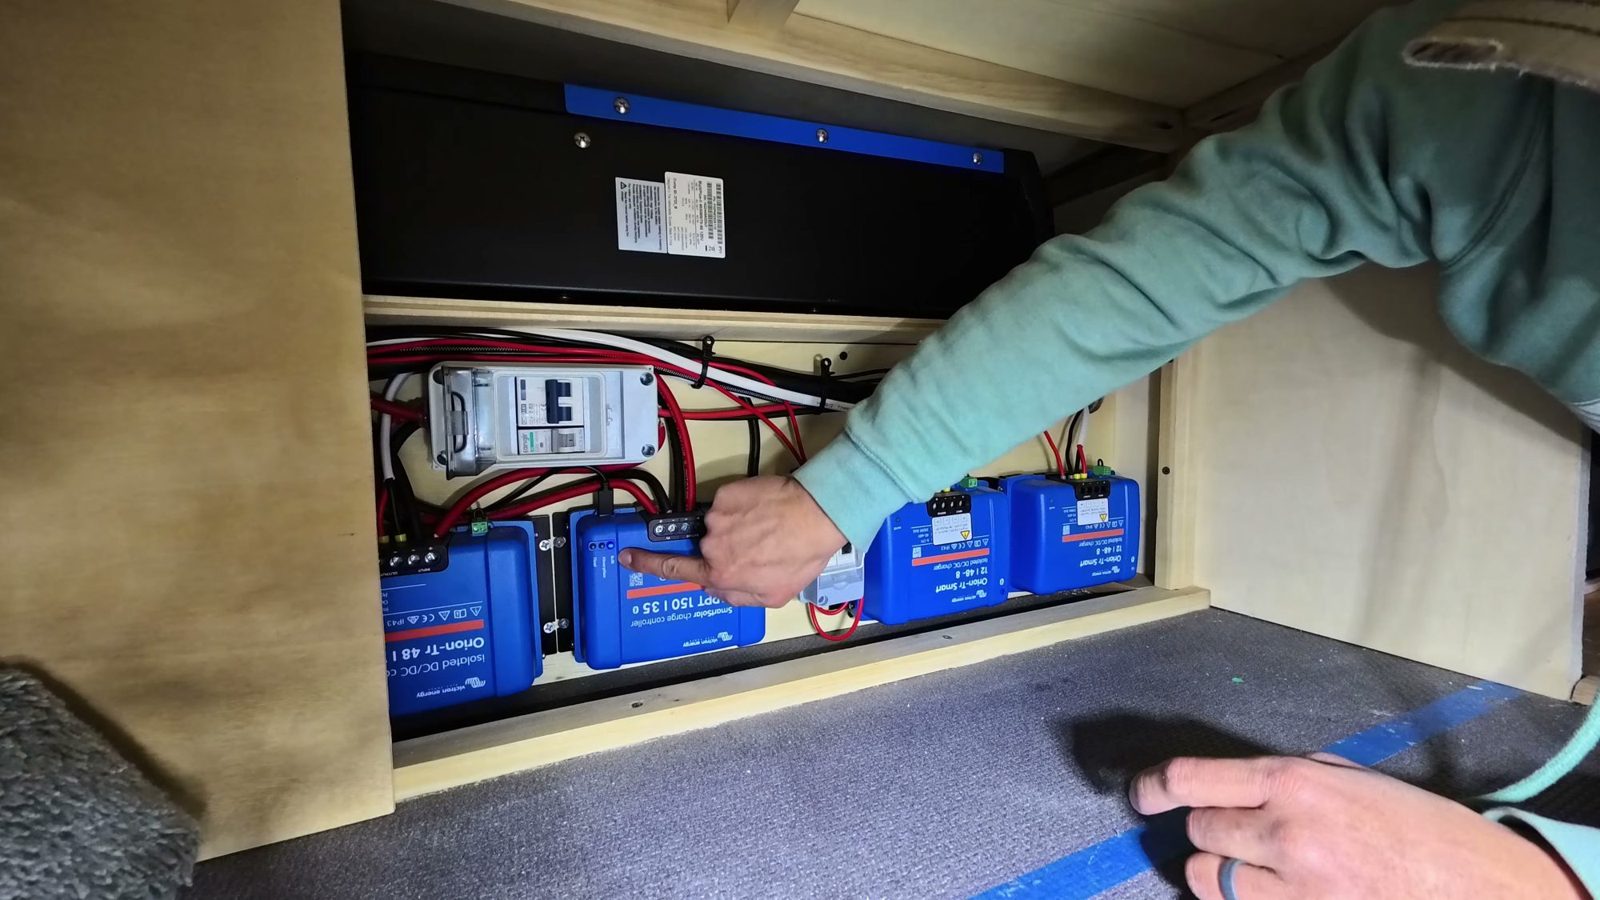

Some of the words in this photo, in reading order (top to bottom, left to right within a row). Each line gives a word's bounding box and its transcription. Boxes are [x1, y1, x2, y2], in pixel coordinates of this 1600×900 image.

[1080, 558, 1098, 567] Smart
[1098, 555, 1122, 565] Orion-Tr
[955, 571, 960, 579] 8
[980, 566, 988, 575] 12
[936, 582, 958, 593] Smart
[959, 577, 988, 589] Orion-Tr
[672, 597, 693, 610] 150
[697, 595, 724, 607] PPT
[643, 601, 660, 614] 35
[693, 606, 733, 619] SmartSolar
[630, 616, 665, 628] controller
[667, 612, 692, 622] charge
[425, 637, 484, 656] Orion-Tr
[402, 648, 420, 659] 48
[400, 661, 439, 677] DC/DC
[416, 690, 440, 698] energy
[442, 685, 465, 694] victron
